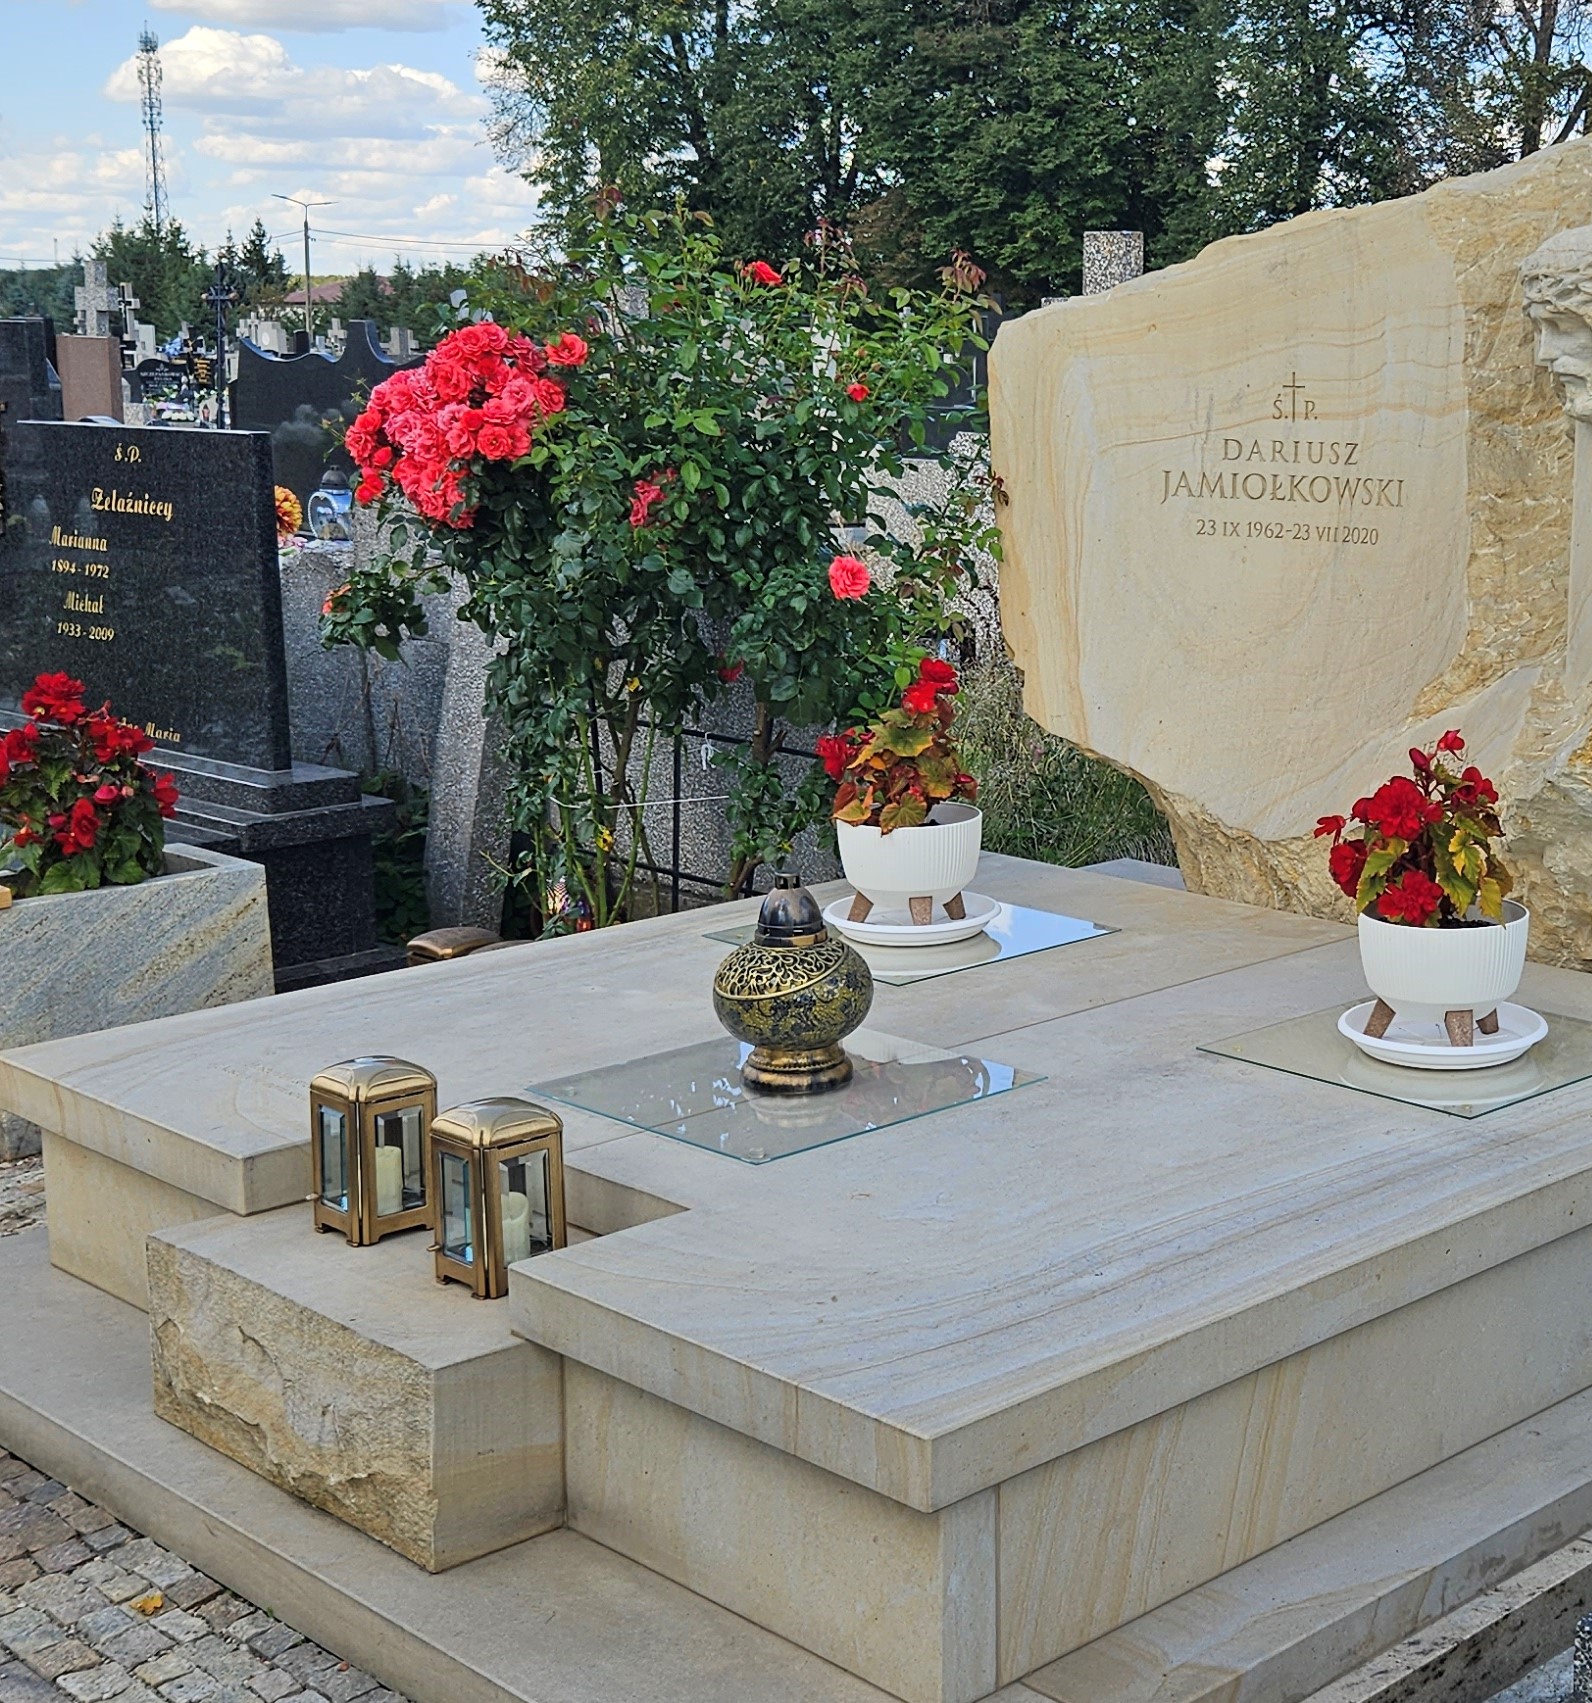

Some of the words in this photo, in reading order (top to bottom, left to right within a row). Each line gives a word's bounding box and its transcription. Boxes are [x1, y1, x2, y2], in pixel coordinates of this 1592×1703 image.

[1222, 438, 1359, 466] DARIUSZ
[1160, 469, 1405, 508] JAMIOŁKOWSKI
[49, 525, 108, 552] Marianna
[1196, 519, 1216, 536] 23
[1222, 521, 1241, 538] IX
[1315, 526, 1339, 543] VII
[1342, 526, 1379, 546] 2020
[144, 722, 181, 742] Maria
